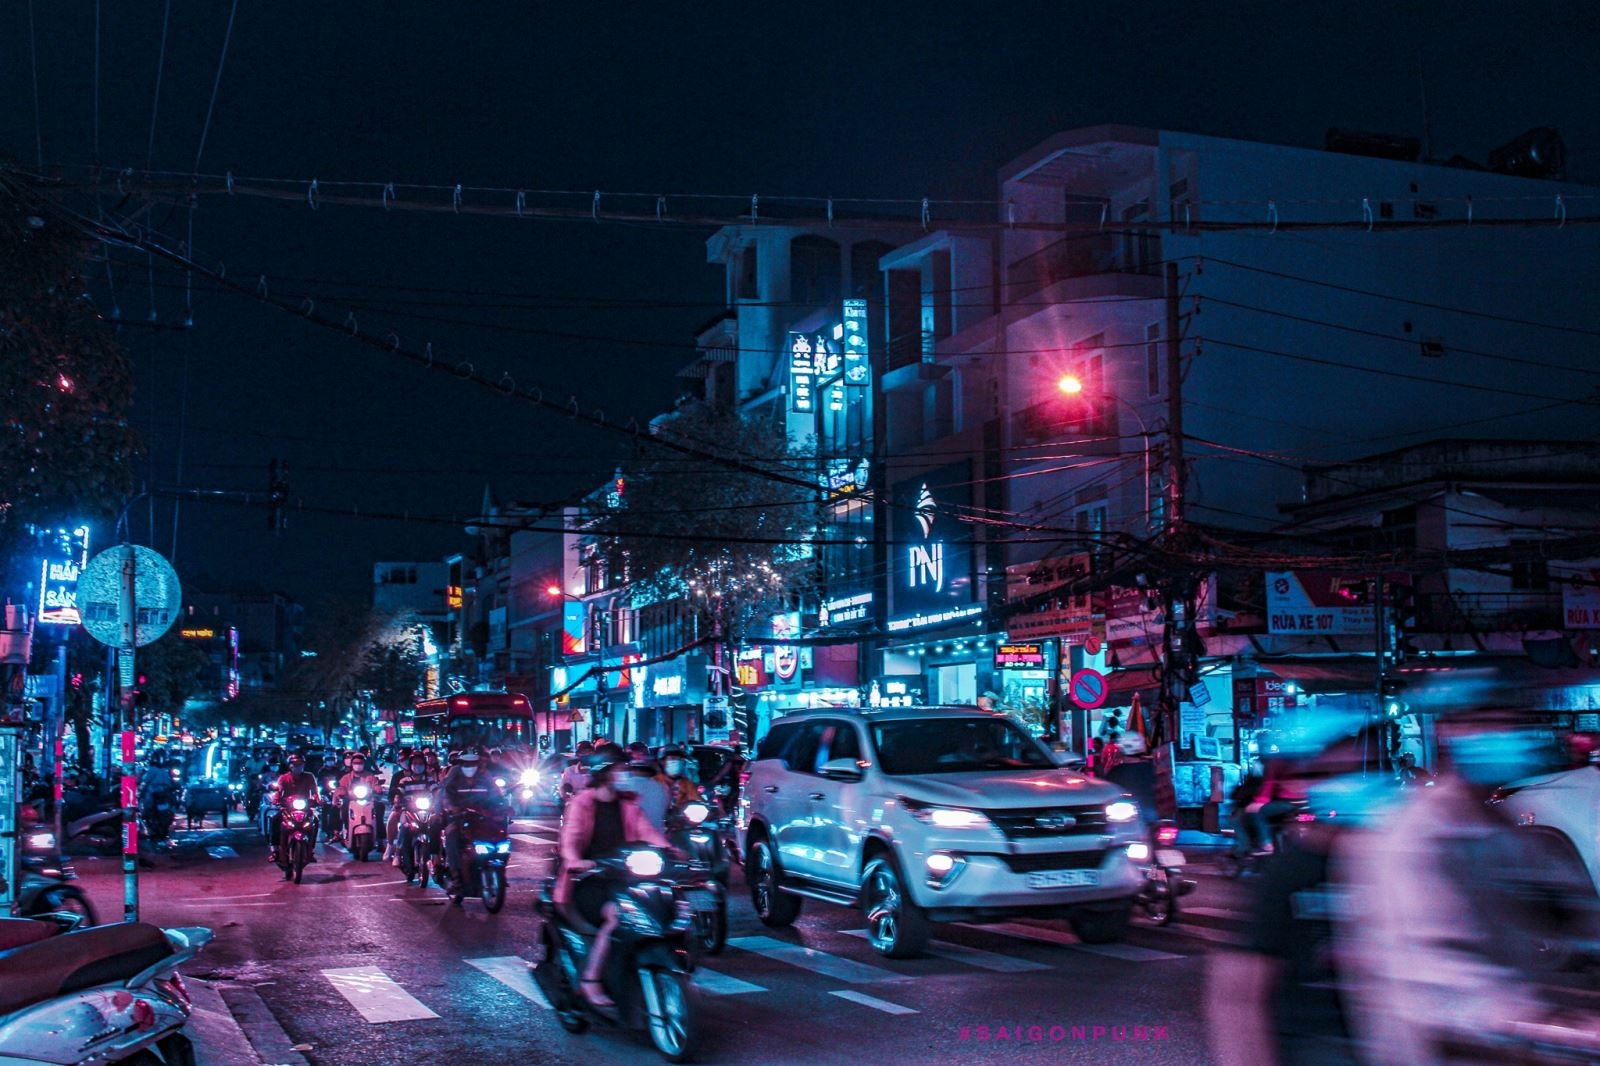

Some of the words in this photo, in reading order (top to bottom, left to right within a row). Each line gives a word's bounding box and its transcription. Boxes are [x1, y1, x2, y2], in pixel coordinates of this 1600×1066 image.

[50, 561, 79, 581] HẢI
[909, 543, 943, 592] PNJ
[46, 586, 77, 607] SẢN
[1299, 614, 1314, 630] XE
[1316, 614, 1334, 630] 107
